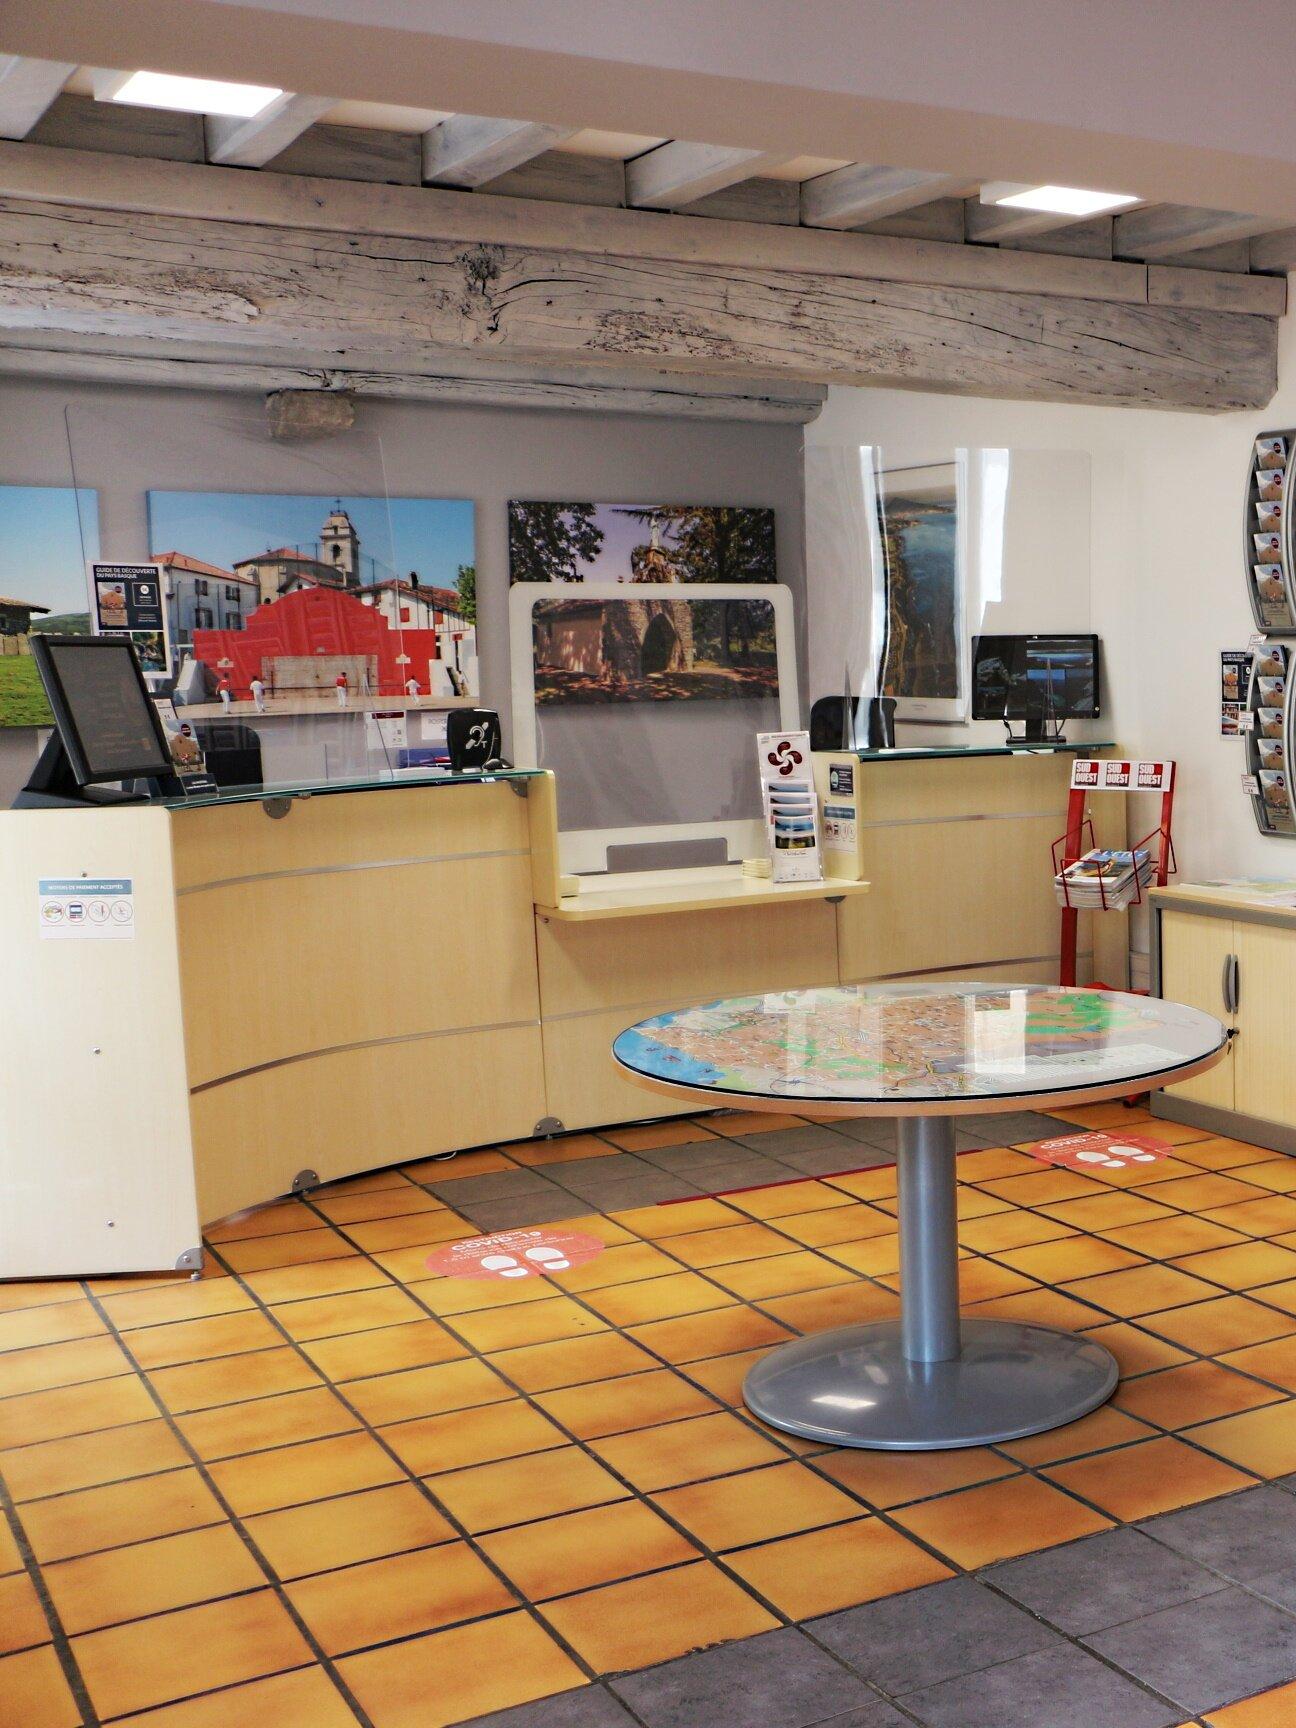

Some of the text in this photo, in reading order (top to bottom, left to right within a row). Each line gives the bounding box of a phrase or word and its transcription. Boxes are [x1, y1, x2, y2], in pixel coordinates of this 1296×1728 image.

[121, 567, 157, 575] DÉCOUVERTE
[1075, 763, 1091, 773] SUD
[1107, 763, 1122, 774] SUD
[1139, 764, 1155, 774] SUD
[1075, 772, 1098, 783] OUEST
[1106, 773, 1130, 784] OUEST
[1138, 774, 1162, 785] OUEST
[1040, 1134, 1109, 1150] COVID-19
[451, 1231, 542, 1251] COVID-19
